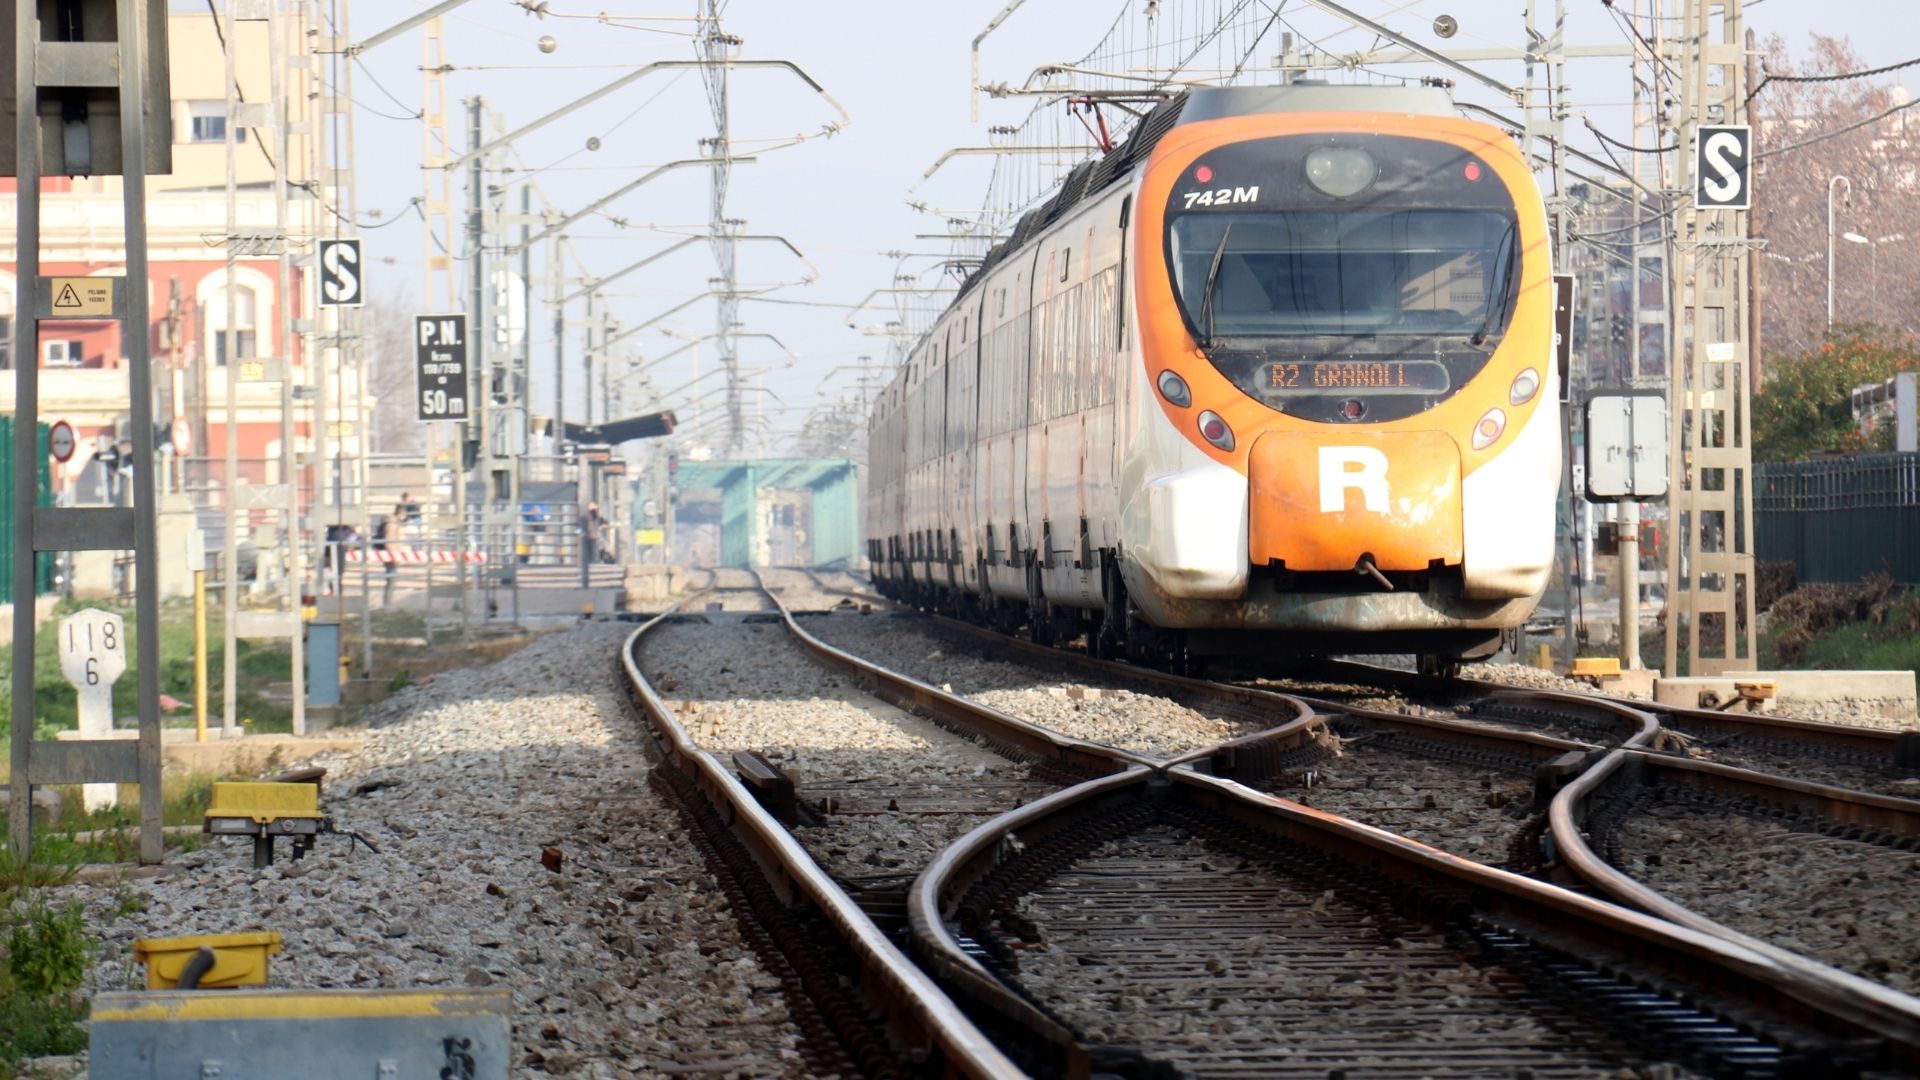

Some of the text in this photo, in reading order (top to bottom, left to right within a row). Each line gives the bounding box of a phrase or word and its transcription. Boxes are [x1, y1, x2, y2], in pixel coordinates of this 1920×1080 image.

[1704, 132, 1742, 202] S
[1184, 186, 1259, 209] 742M
[323, 242, 358, 302] S
[420, 320, 462, 346] P.N.
[1272, 363, 1300, 387] R2
[422, 389, 465, 415] 50 m
[1317, 445, 1391, 513] R
[69, 621, 116, 653] 118
[85, 657, 99, 686] 6
